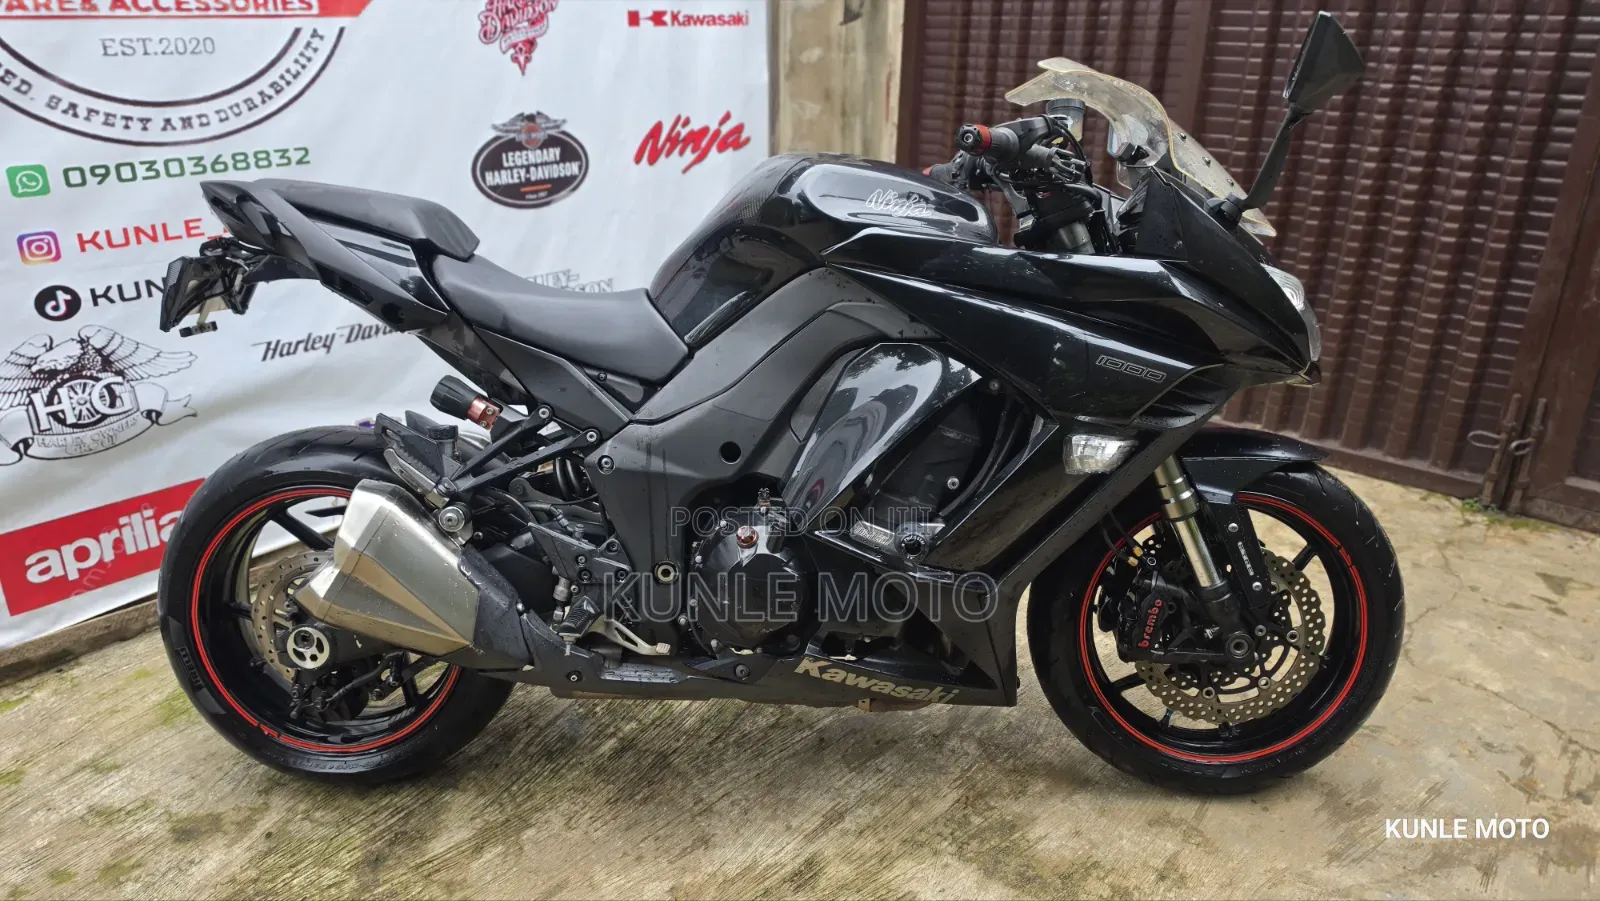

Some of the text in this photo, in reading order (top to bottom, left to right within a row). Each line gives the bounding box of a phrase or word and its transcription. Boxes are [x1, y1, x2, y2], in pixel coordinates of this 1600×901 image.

[670, 10, 749, 27] Kawasaki
[99, 36, 215, 57] EST.2020
[44, 94, 153, 132] SAFETY
[160, 112, 211, 132] AND
[634, 110, 751, 174] Ninja
[62, 147, 311, 188] 09030368832
[502, 147, 561, 168] LEGENDARY
[484, 162, 581, 187] HARLEY-DAVIDSON
[866, 188, 933, 217] Ninja
[1095, 354, 1167, 383] 1000
[1138, 599, 1163, 649] brembo
[794, 656, 960, 704] Kawasaki
